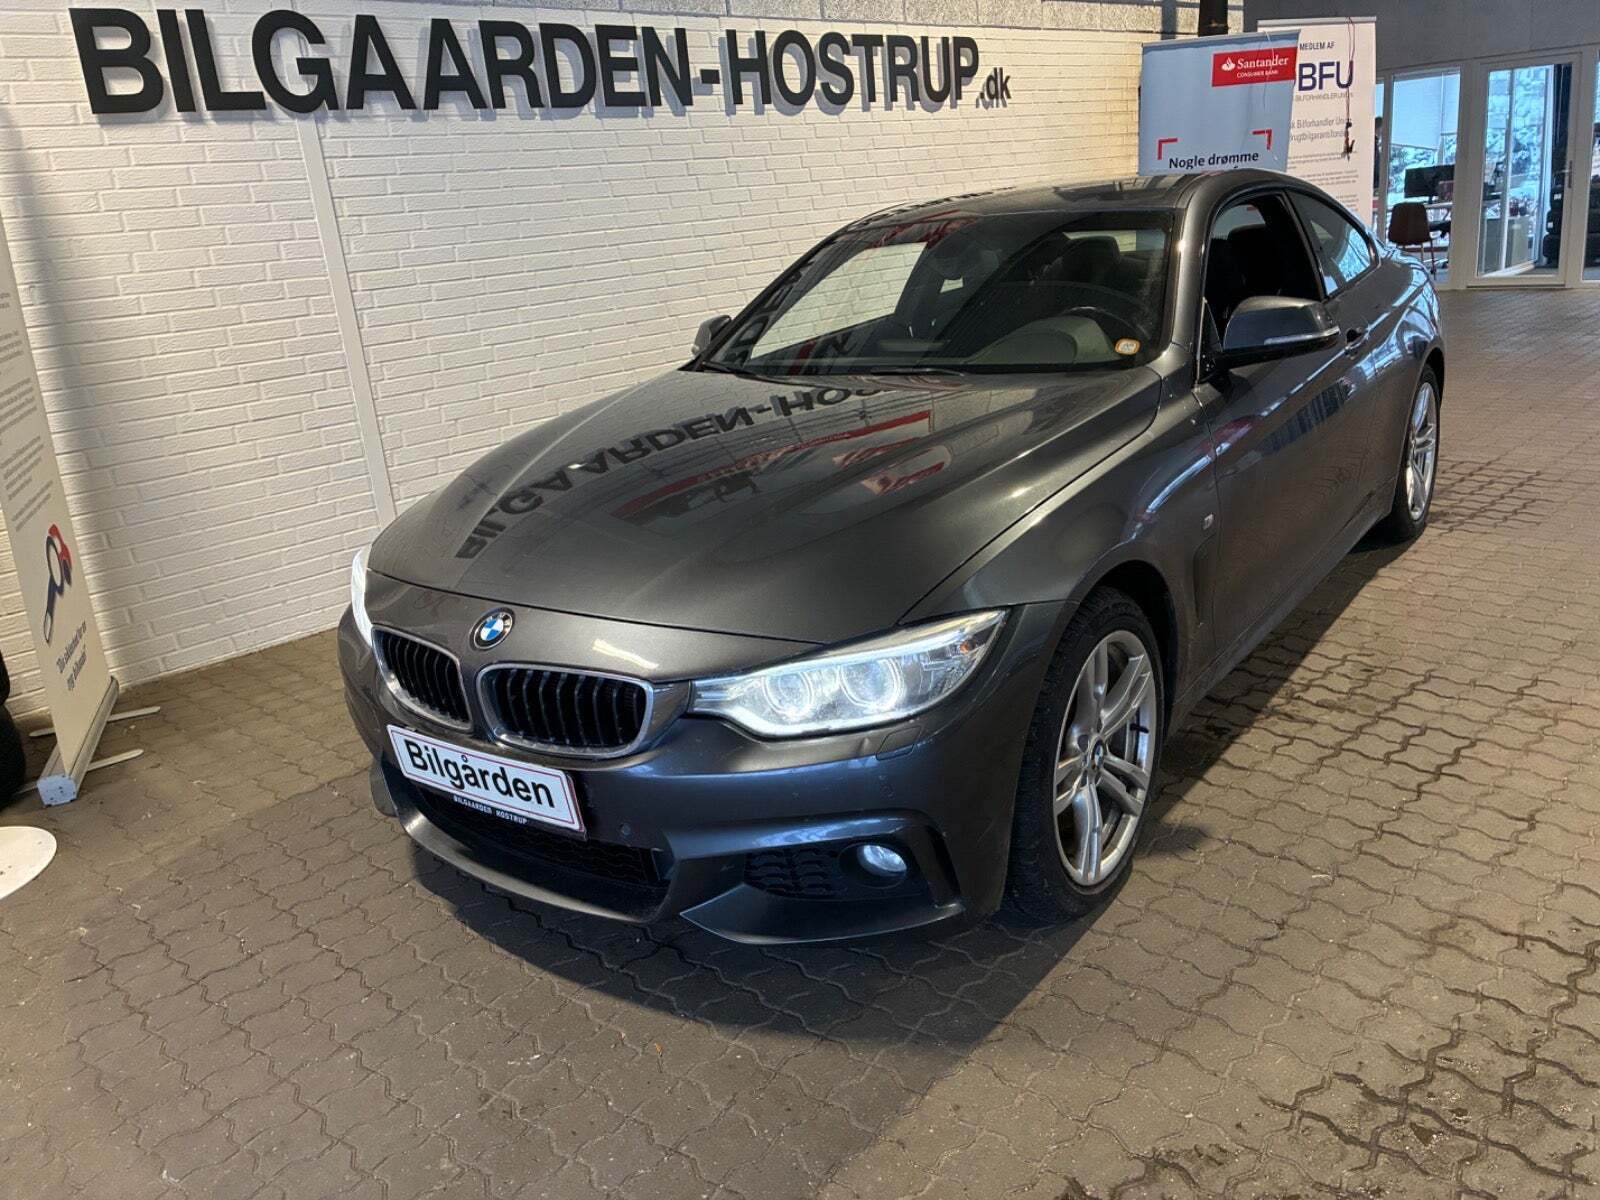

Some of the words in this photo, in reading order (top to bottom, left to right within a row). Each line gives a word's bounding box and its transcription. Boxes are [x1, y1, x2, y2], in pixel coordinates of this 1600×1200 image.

[1300, 42, 1325, 50] MEDLEM
[1327, 41, 1335, 49] AF
[1237, 54, 1289, 69] Santander
[1298, 61, 1353, 91] BFU
[1169, 155, 1205, 169] Nogle
[1208, 152, 1259, 165] drømme
[404, 739, 554, 808] Bilgården
